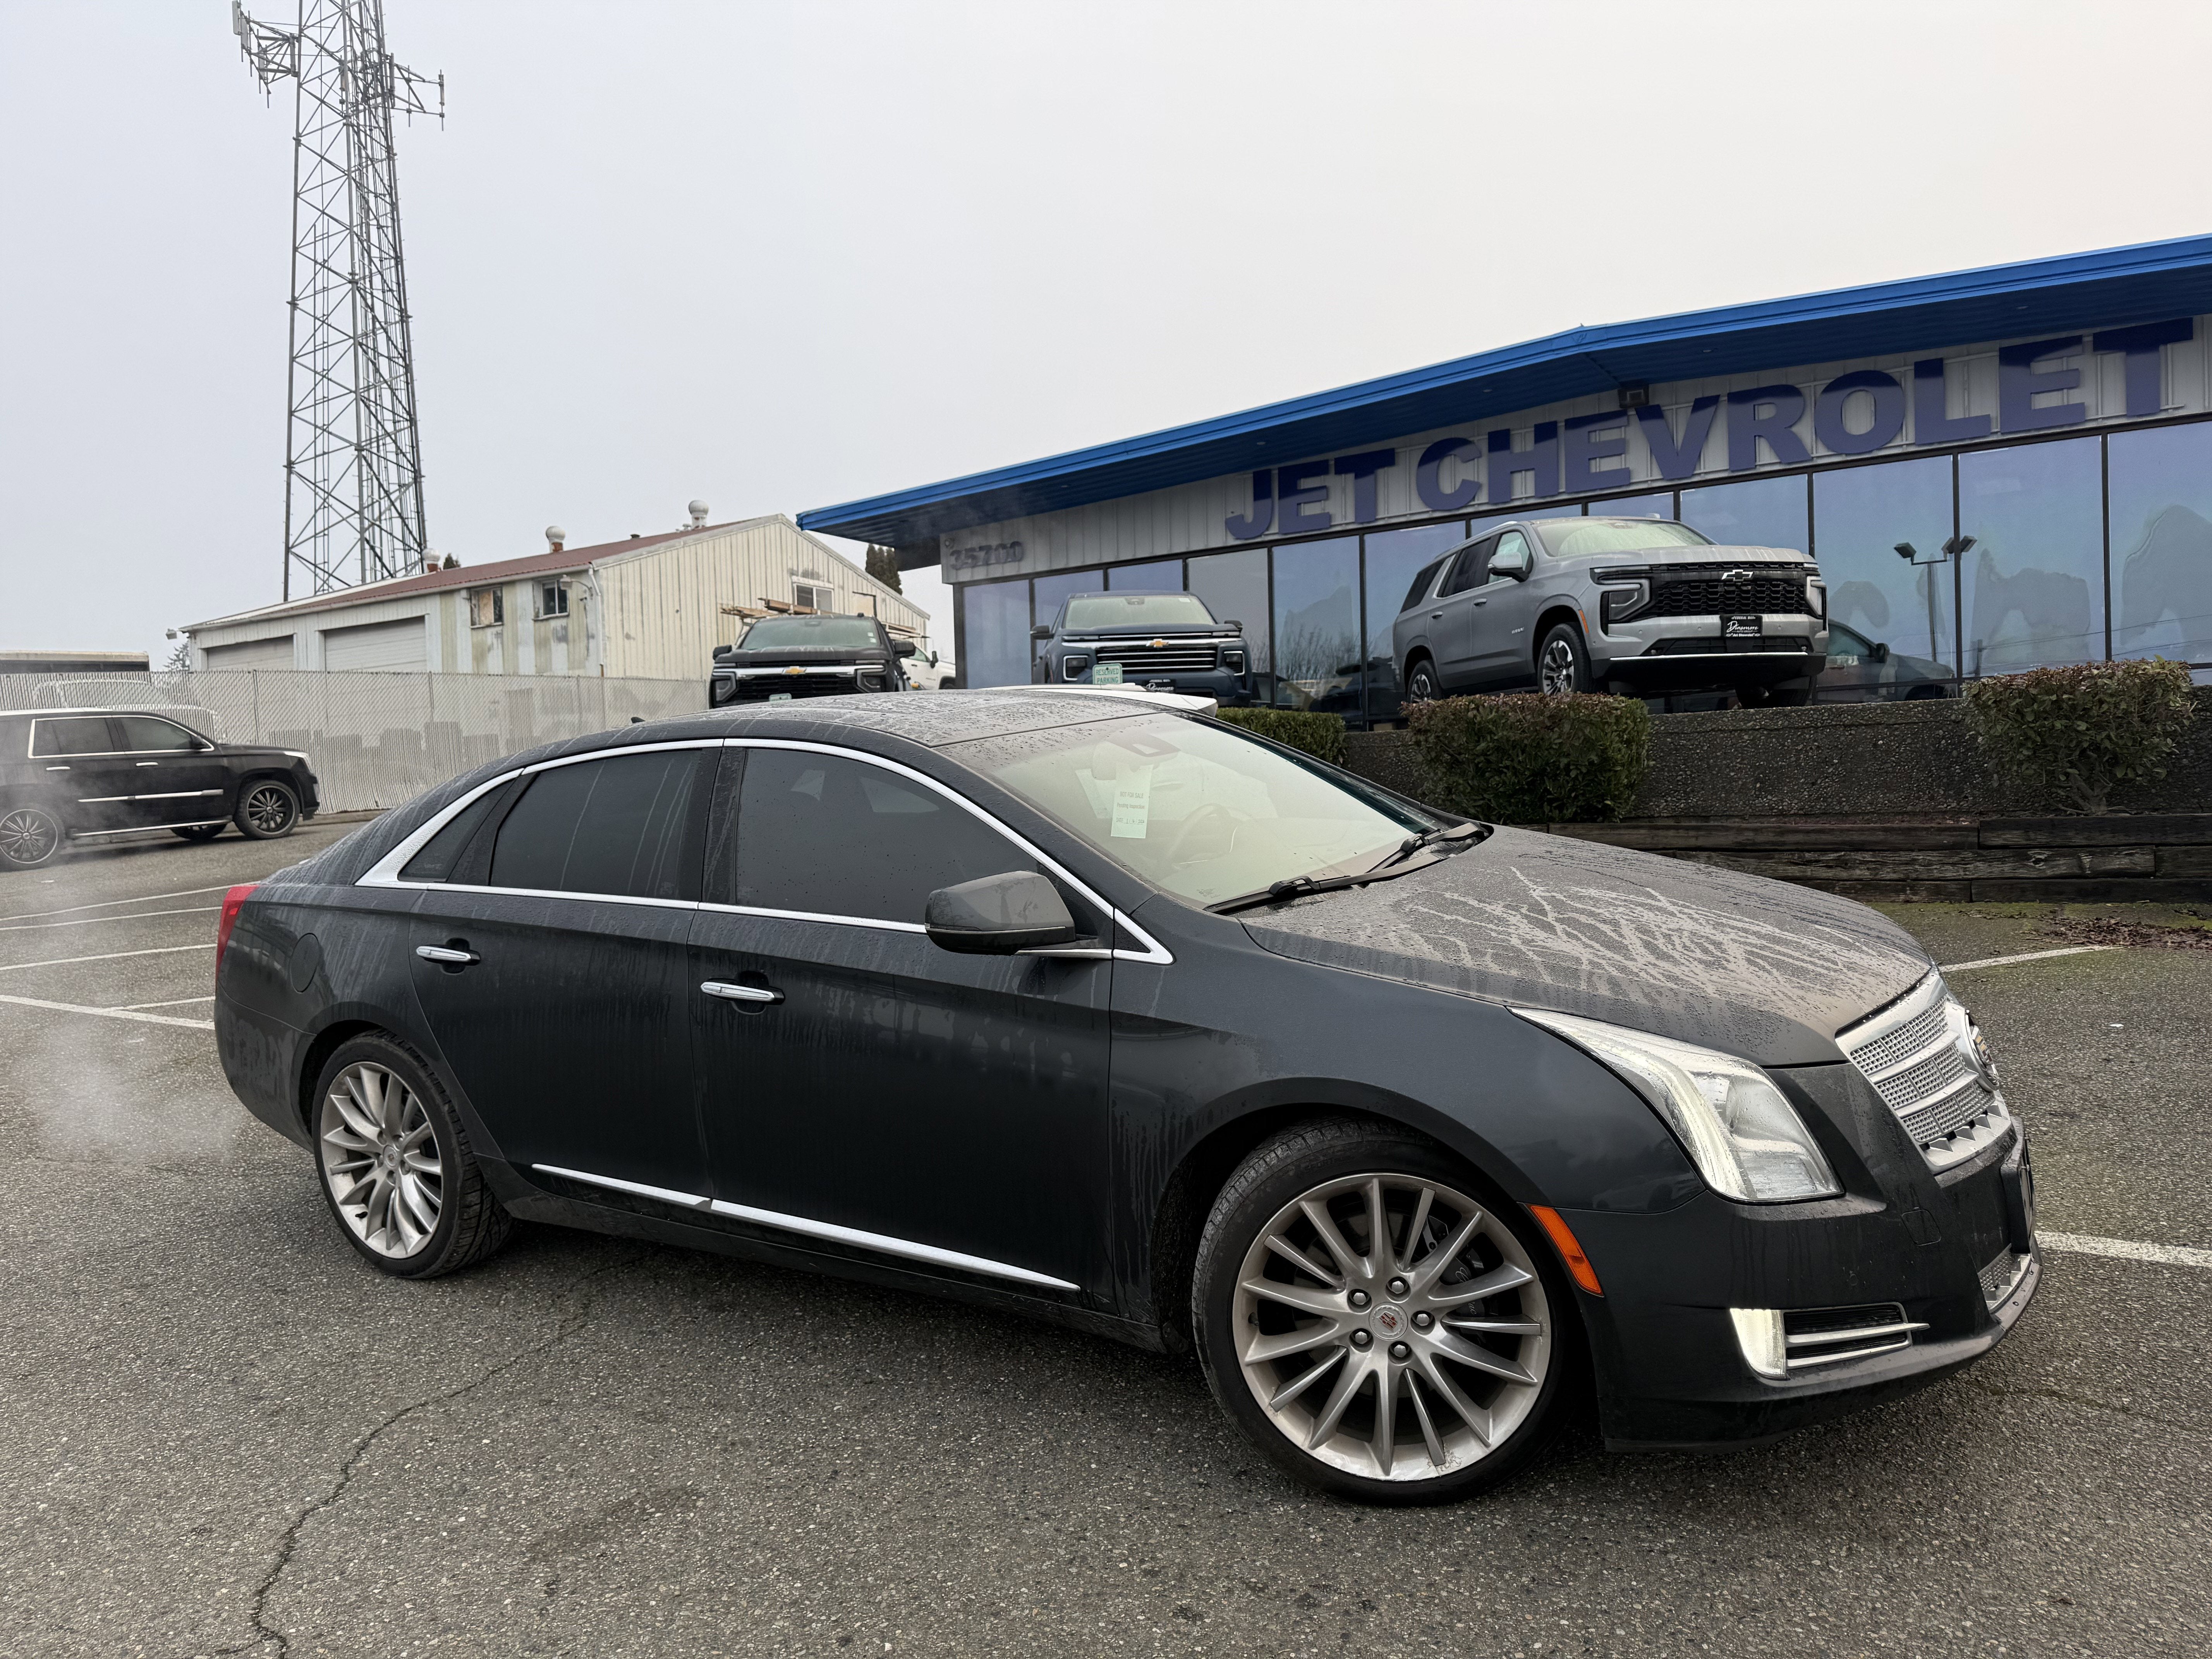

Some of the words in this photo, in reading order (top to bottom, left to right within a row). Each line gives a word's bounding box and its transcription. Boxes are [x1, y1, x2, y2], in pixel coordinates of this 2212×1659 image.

[1225, 448, 1395, 540] JET
[1416, 317, 2193, 510] CHEVROLET
[950, 541, 1024, 571] 35700
[1726, 620, 1759, 632] Dinsmore
